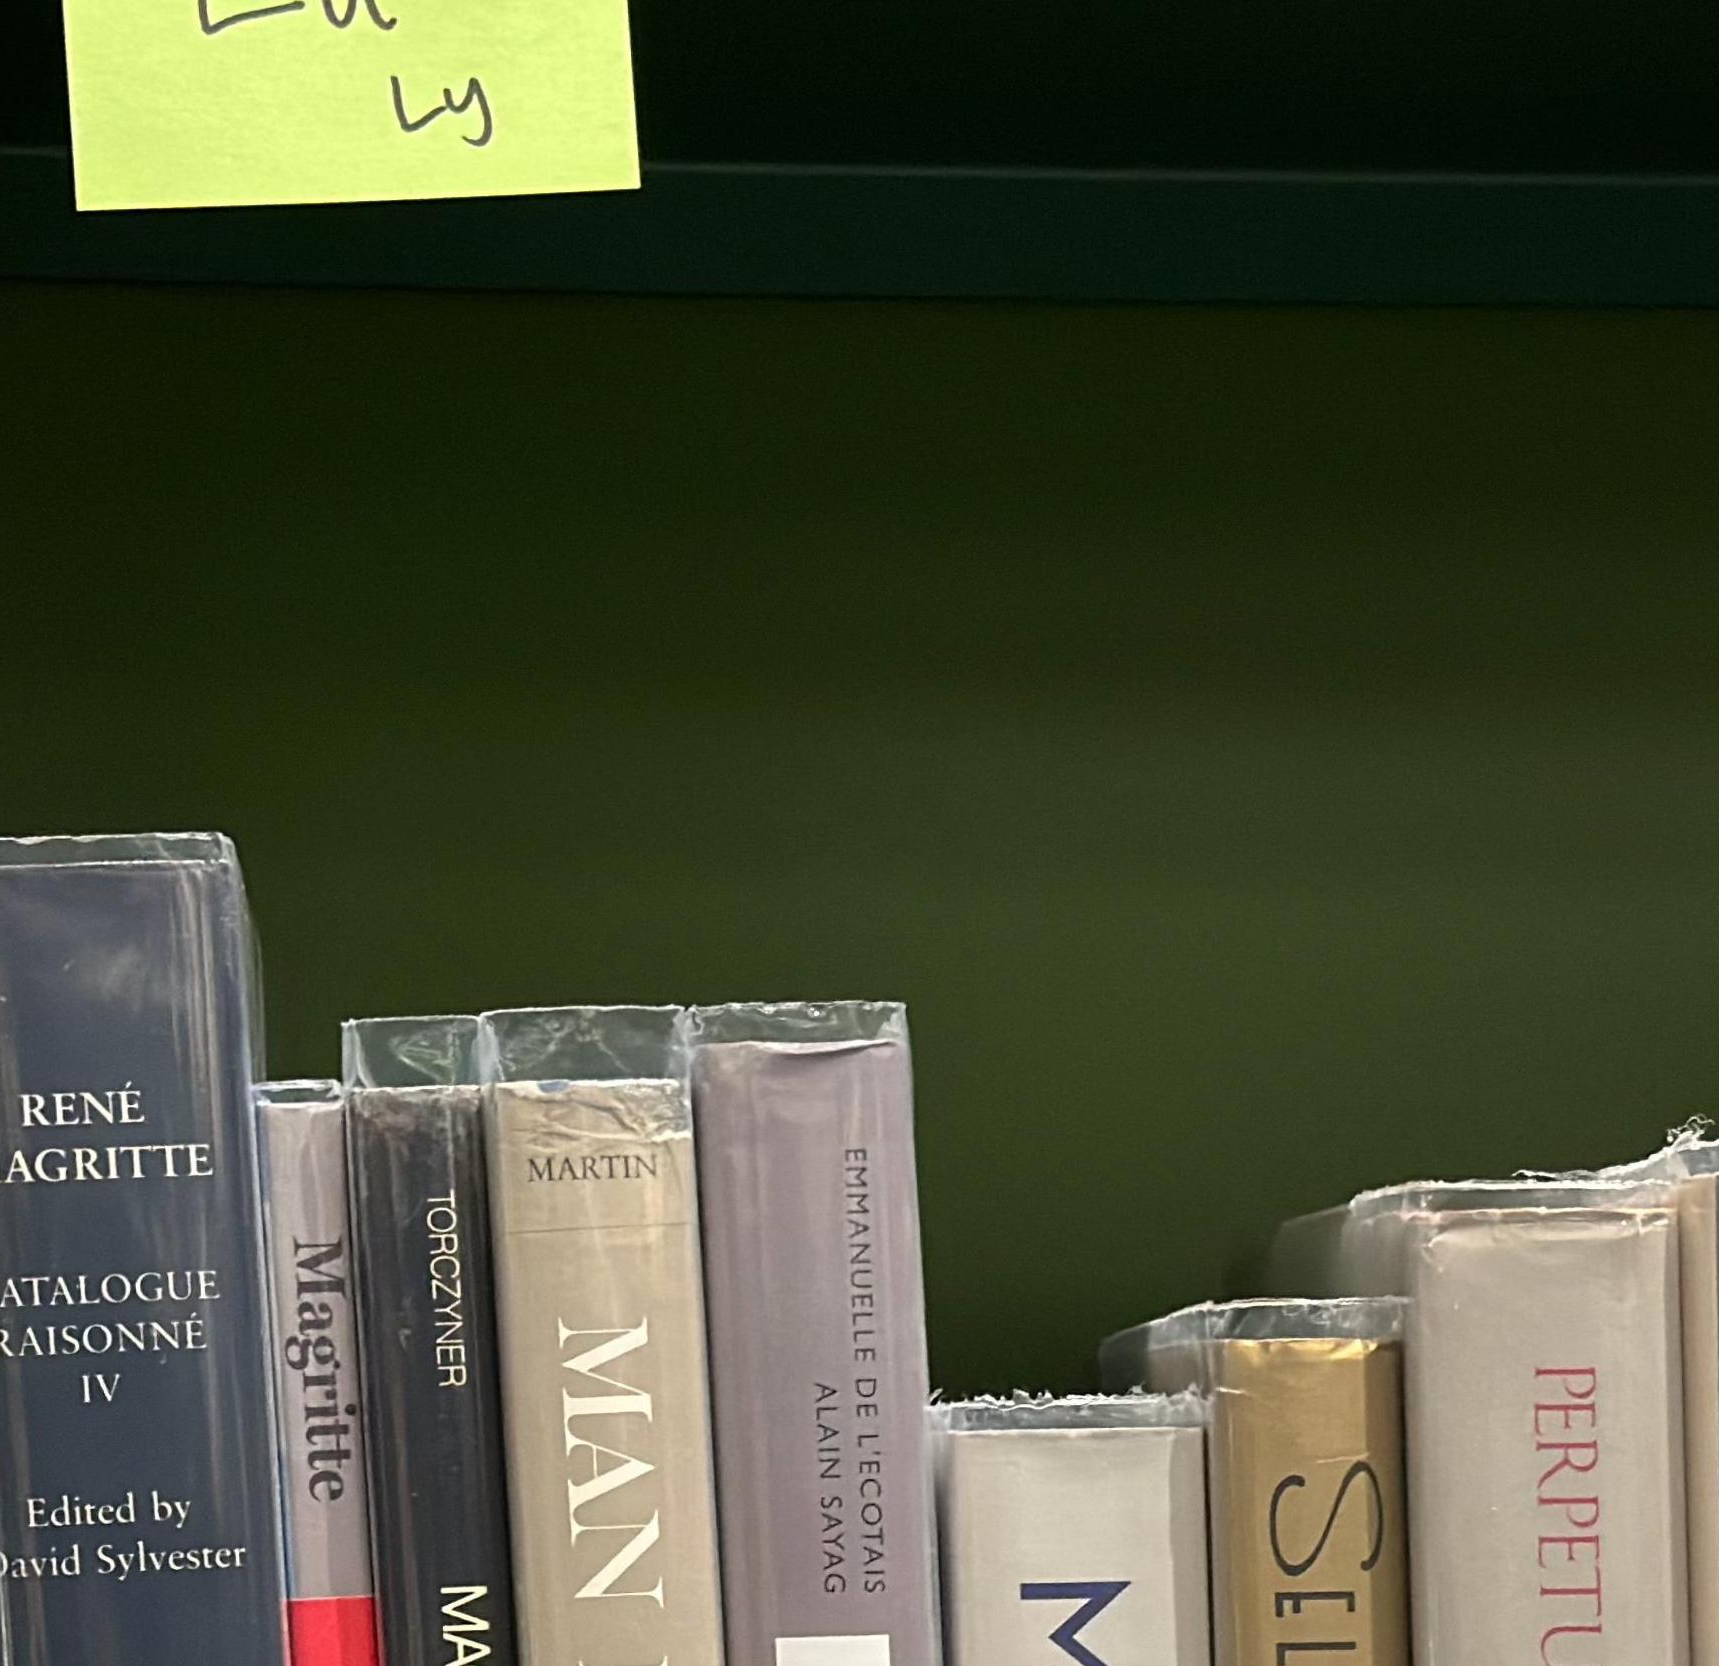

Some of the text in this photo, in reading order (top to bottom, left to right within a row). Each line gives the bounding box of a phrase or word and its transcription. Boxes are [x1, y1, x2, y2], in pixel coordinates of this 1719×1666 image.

[21, 1082, 145, 1127] RENÉ
[527, 1153, 658, 1183] MARTIN
[425, 1188, 468, 1390] TORCZYNER
[82, 1373, 121, 1404] IV
[284, 1235, 360, 1503] Magritte
[844, 1147, 886, 1595] EMMANUELLE DE L'ECOTAIS
[27, 1493, 191, 1528] Edited by
[558, 1317, 665, 1608] MAN
[813, 1382, 846, 1596] ALAIN SAYAG
[97, 1542, 247, 1581] Sylvester
